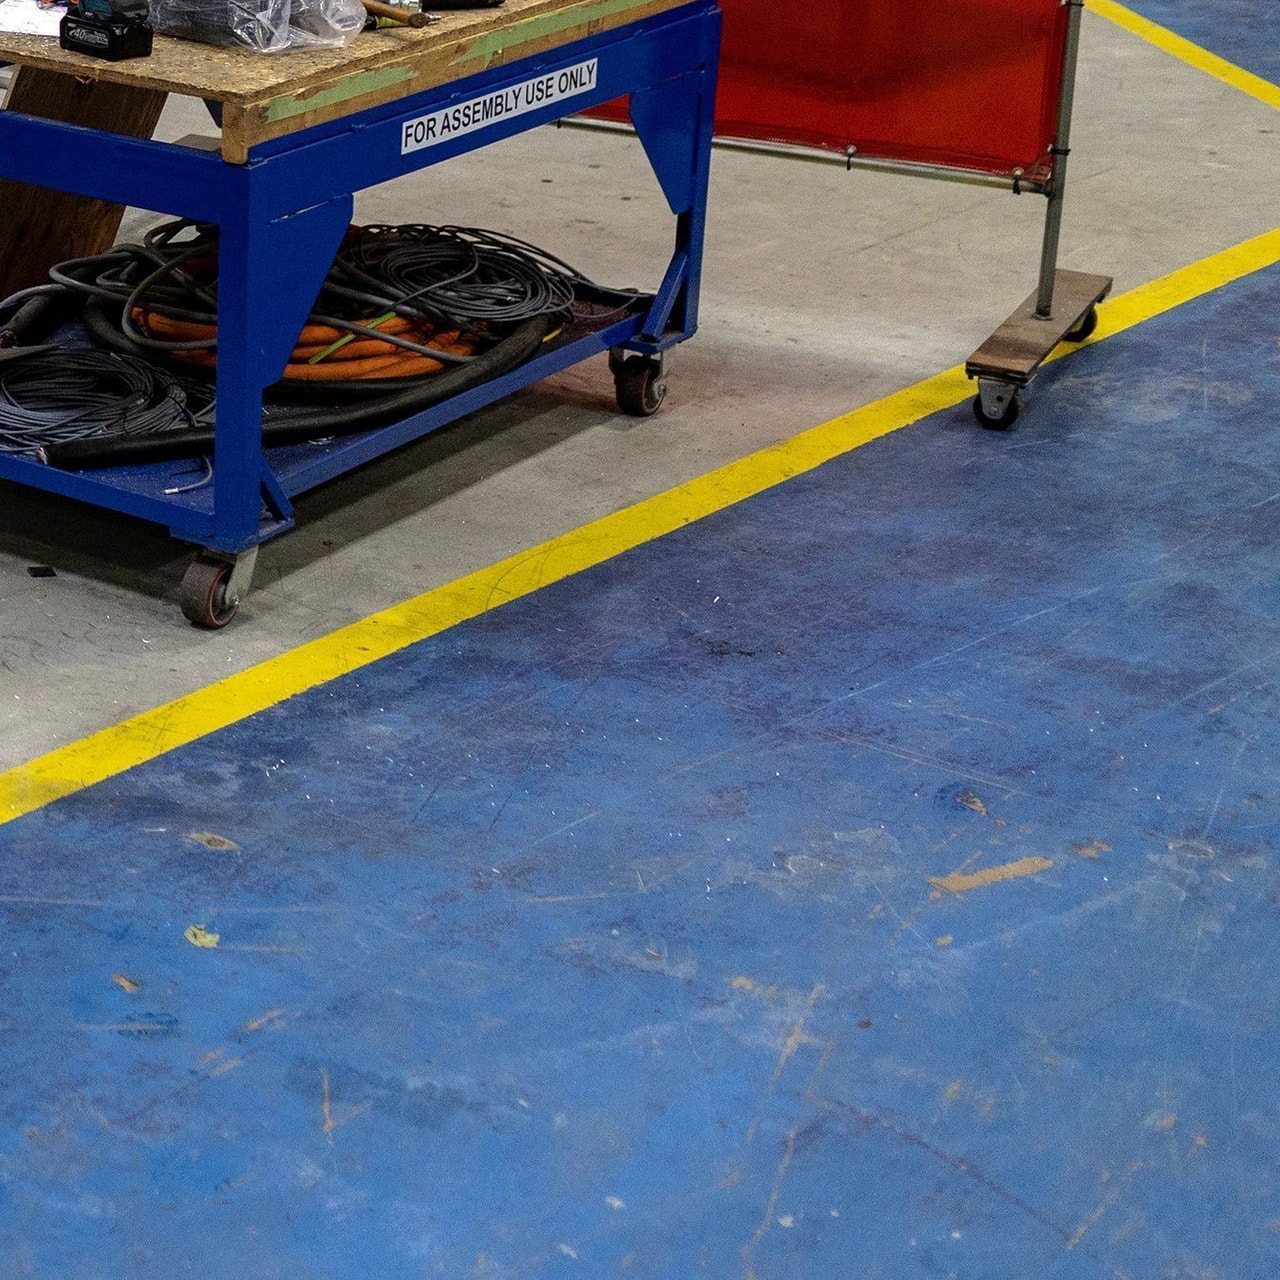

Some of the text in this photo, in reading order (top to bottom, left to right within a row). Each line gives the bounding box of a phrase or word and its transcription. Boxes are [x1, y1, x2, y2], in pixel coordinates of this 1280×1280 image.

[404, 62, 596, 148] FOR ASSEMBLY USE ONLY
